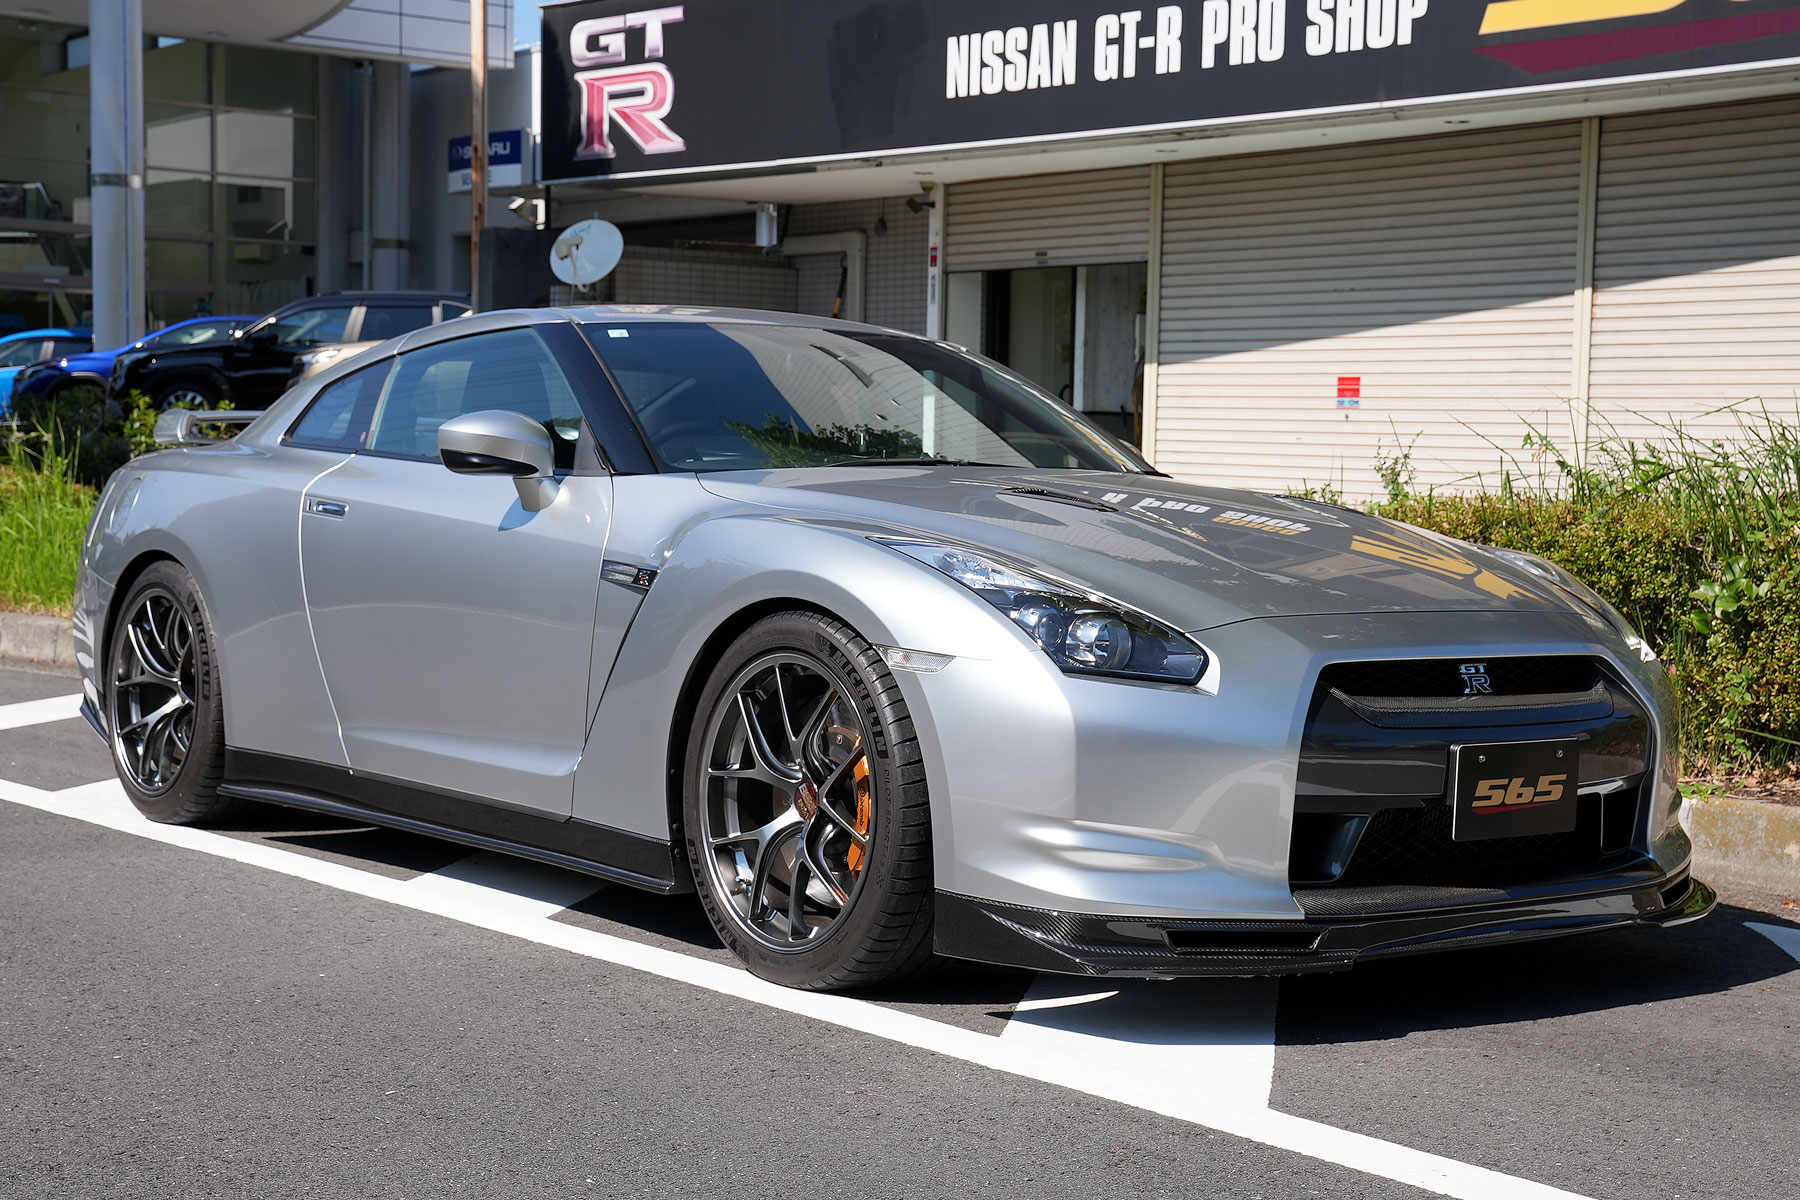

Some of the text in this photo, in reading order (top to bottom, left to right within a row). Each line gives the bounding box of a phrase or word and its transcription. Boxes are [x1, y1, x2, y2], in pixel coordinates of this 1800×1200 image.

[569, 5, 685, 67] GT
[946, 19, 1078, 99] NISSAN
[1094, 5, 1182, 82] GT-R
[1201, 0, 1286, 69] PRO
[1305, 0, 1428, 56] SHOP
[573, 62, 687, 161] R
[193, 610, 210, 695] MICHELIN
[1460, 663, 1488, 674] GT
[1461, 673, 1493, 694] R
[832, 649, 888, 752] MICHELIN
[884, 768, 892, 804] PILOT
[1471, 773, 1568, 808] 565
[884, 809, 892, 852] SPORT
[687, 846, 735, 943] MICHELIN
